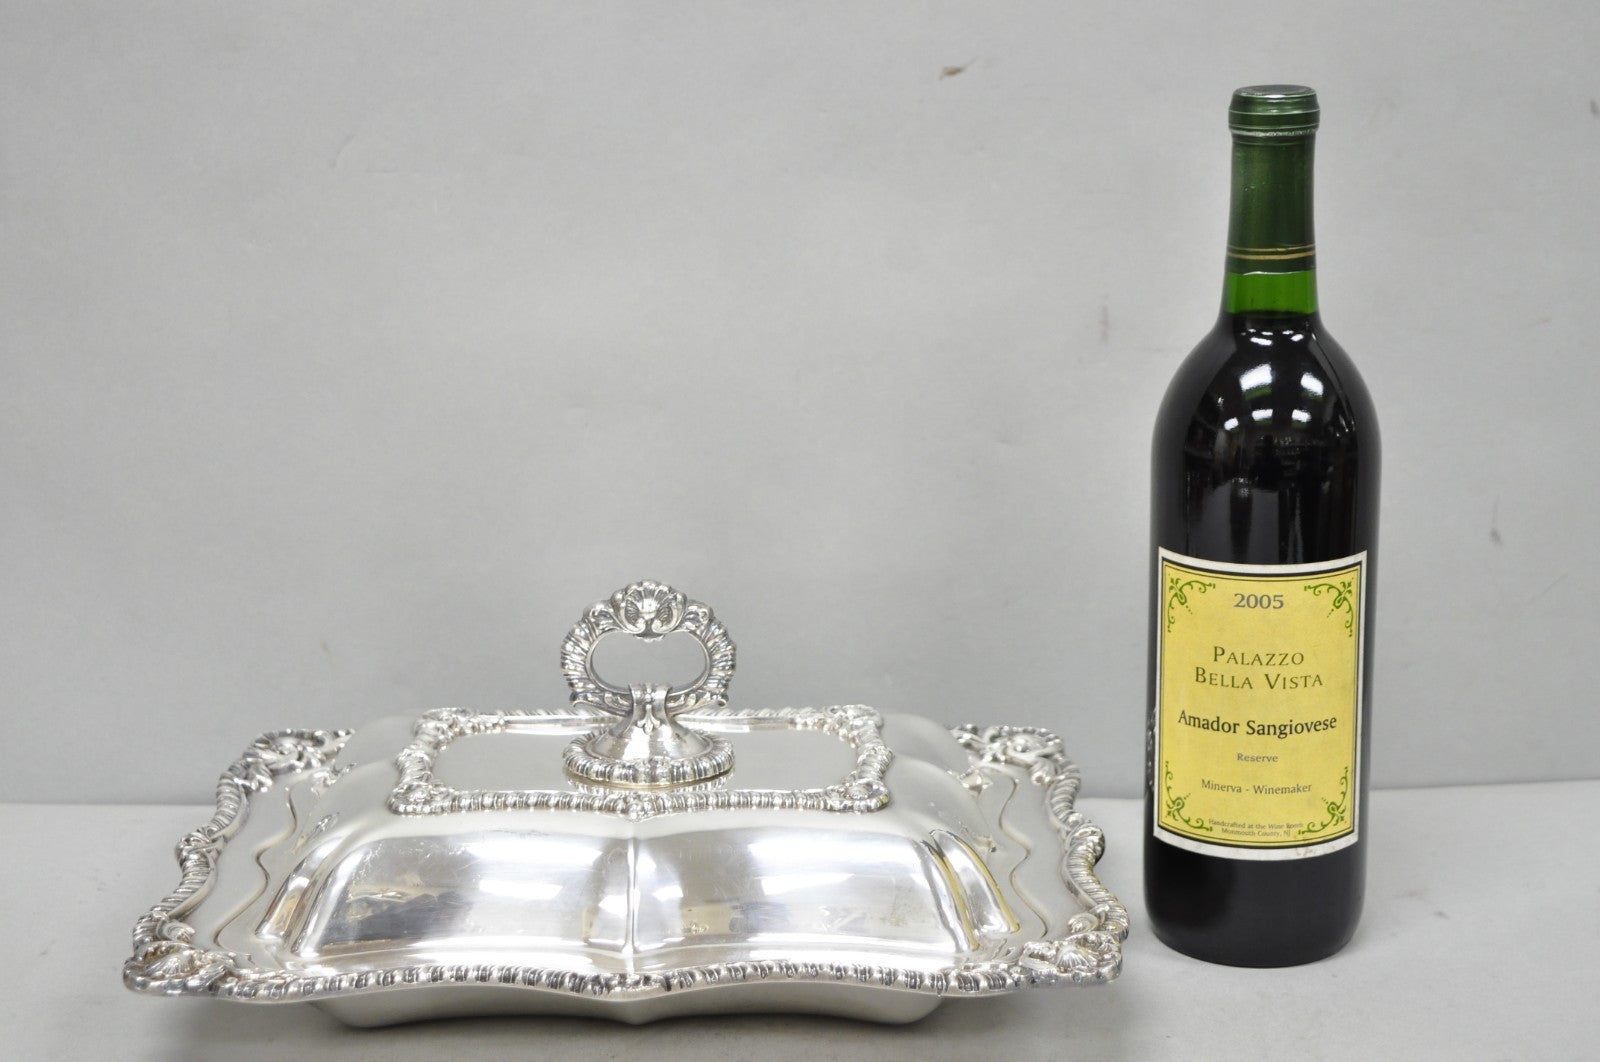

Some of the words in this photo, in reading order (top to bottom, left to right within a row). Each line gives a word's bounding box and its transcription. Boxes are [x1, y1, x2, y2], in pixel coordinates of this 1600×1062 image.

[1233, 593, 1284, 609] 2005
[1178, 710, 1240, 734] Amador
[1246, 716, 1337, 739] Sangiovese
[1237, 752, 1278, 763] Reserve
[1201, 779, 1242, 793] Minerva
[1253, 784, 1312, 795] Winemaker
[1208, 818, 1247, 829] Handcrafted
[1221, 827, 1255, 837] Monmouth
